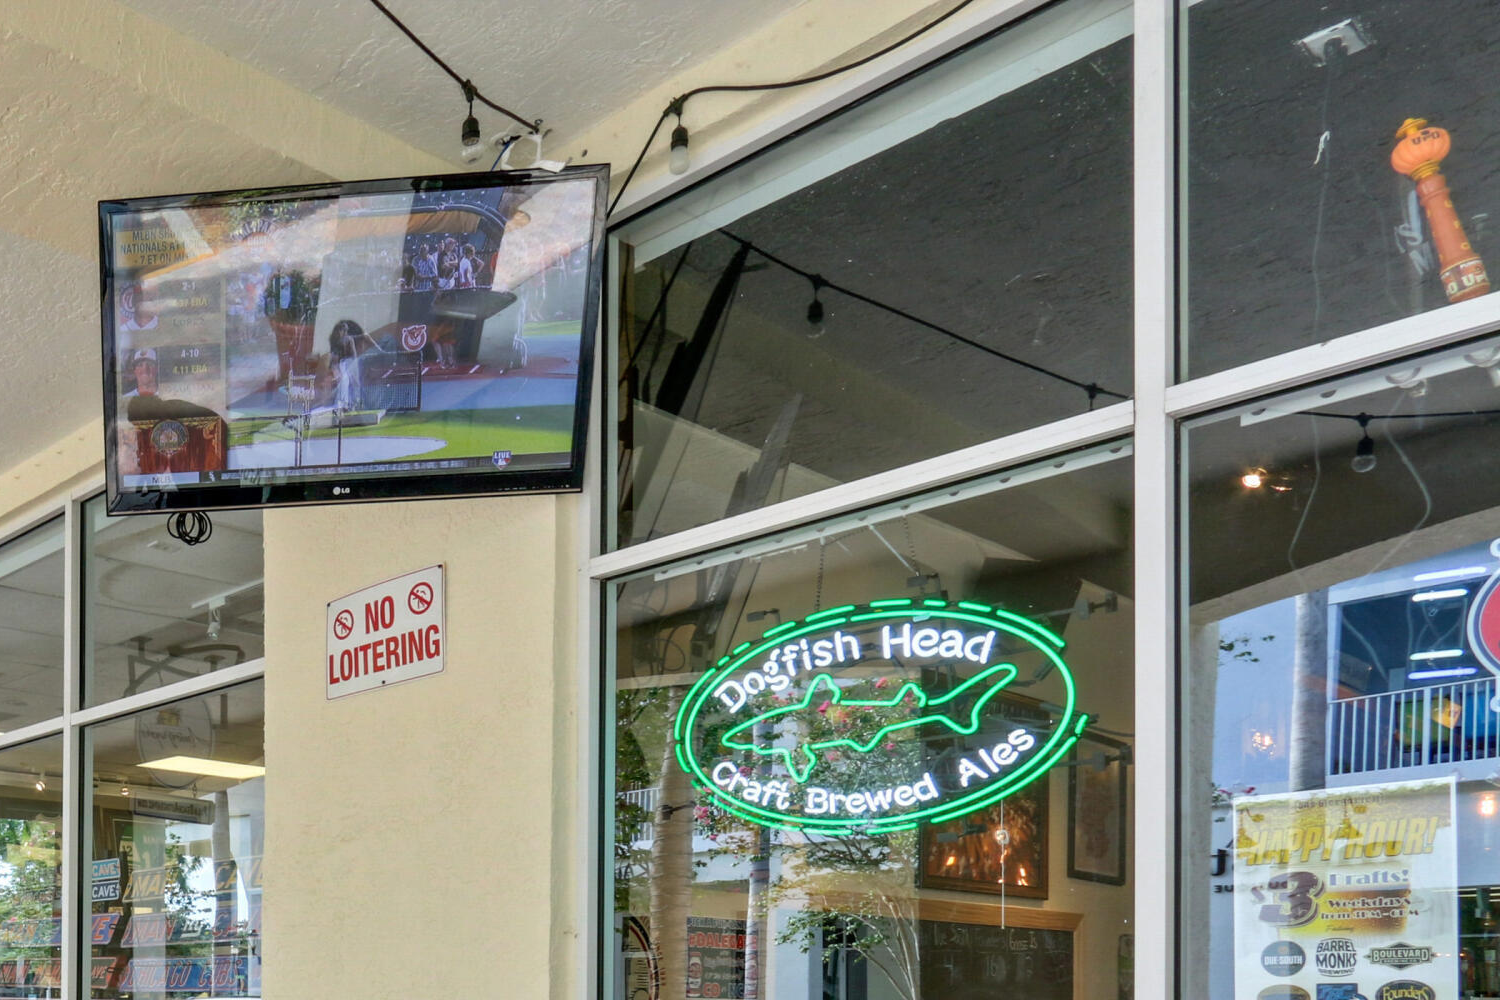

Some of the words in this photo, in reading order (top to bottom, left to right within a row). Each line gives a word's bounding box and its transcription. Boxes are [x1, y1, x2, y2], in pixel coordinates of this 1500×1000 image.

[120, 242, 168, 255] NATIONALS
[181, 281, 196, 291] 2-1
[180, 349, 200, 358] 4-10
[191, 365, 208, 374] ERA
[365, 595, 395, 634] NO
[329, 624, 440, 685] LOITERING
[713, 631, 861, 714] Dogfish
[882, 623, 996, 664] Head
[712, 761, 791, 810] Craft
[804, 772, 939, 815] Brewed
[958, 728, 1036, 788] Ales
[1245, 825, 1337, 866] HAPPY
[1344, 816, 1439, 860] HOUR!
[92, 863, 116, 876] CAVE
[1329, 869, 1410, 886] Drafts!
[92, 885, 116, 897] CAVE
[1328, 896, 1412, 909] Weekdays
[1316, 940, 1357, 953] BARREL
[1315, 952, 1357, 969] MONKS
[1373, 948, 1429, 962] BOULEVARD
